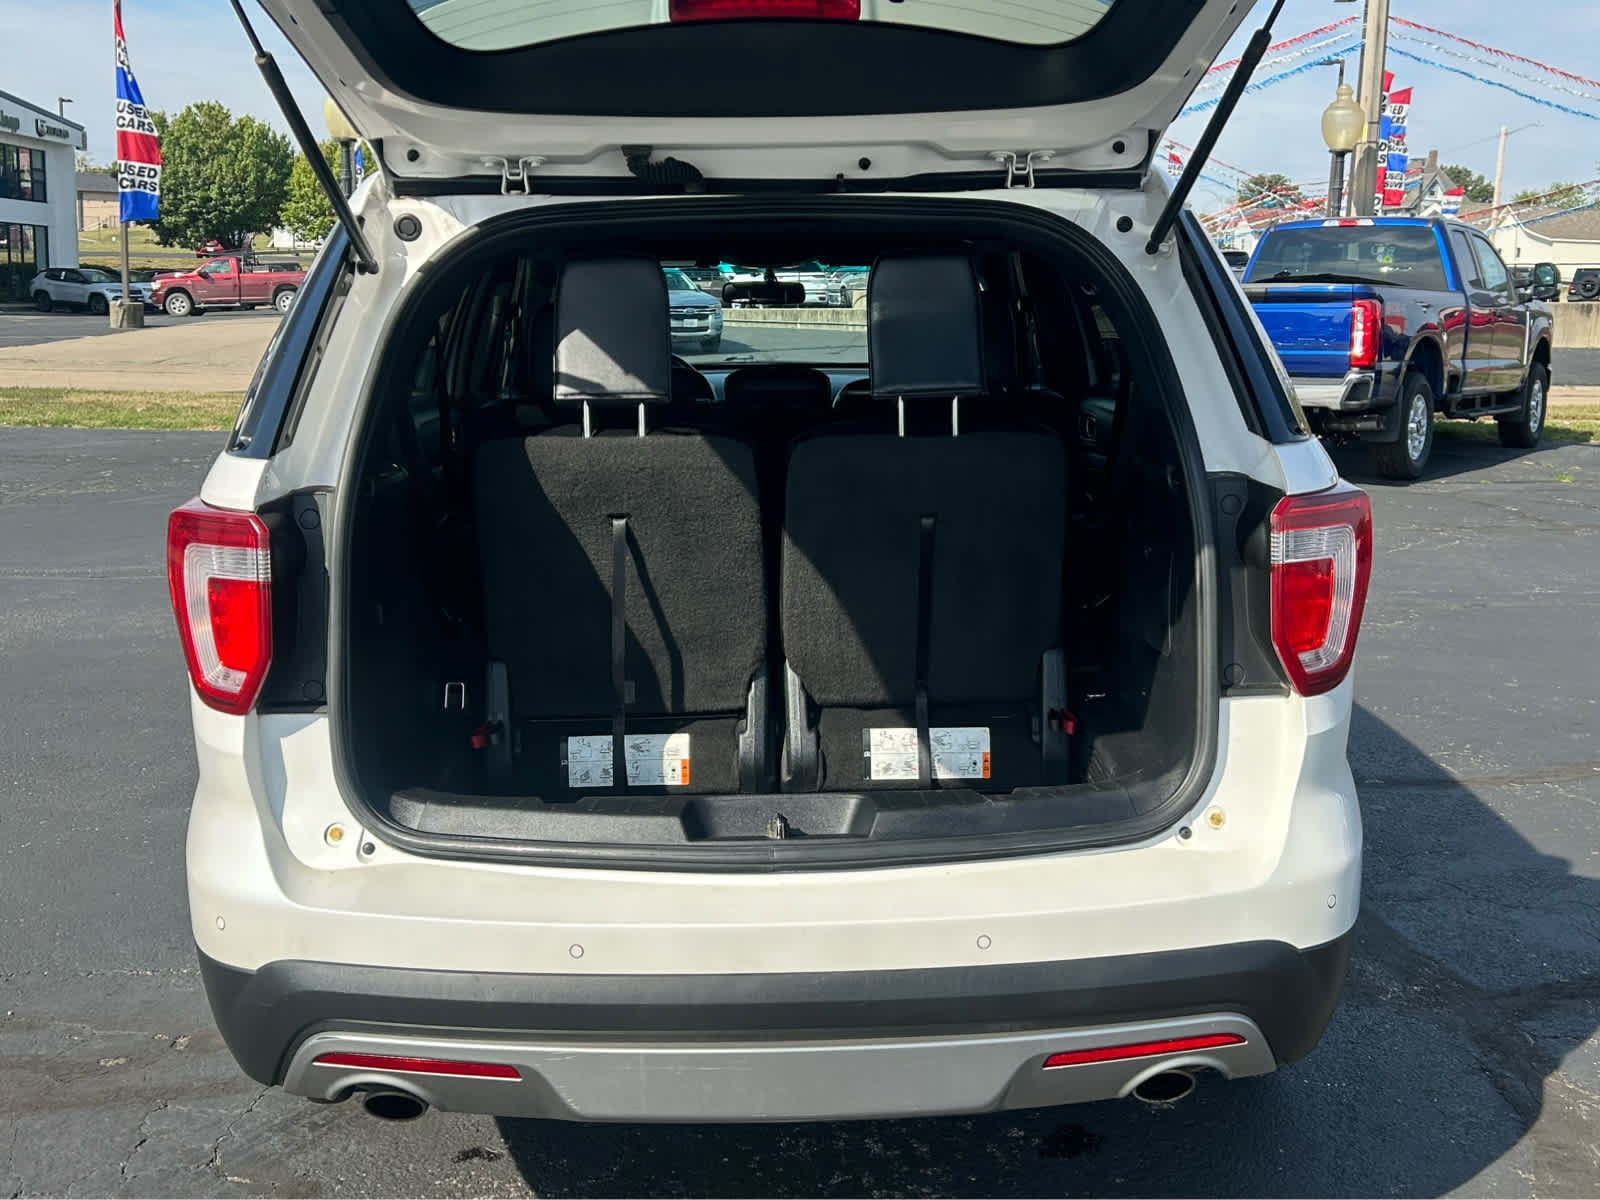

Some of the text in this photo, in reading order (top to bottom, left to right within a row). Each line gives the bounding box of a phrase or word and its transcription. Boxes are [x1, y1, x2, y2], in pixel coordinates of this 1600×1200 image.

[116, 115, 154, 133] CARS
[118, 162, 158, 179] USED
[119, 177, 158, 192] CARS
